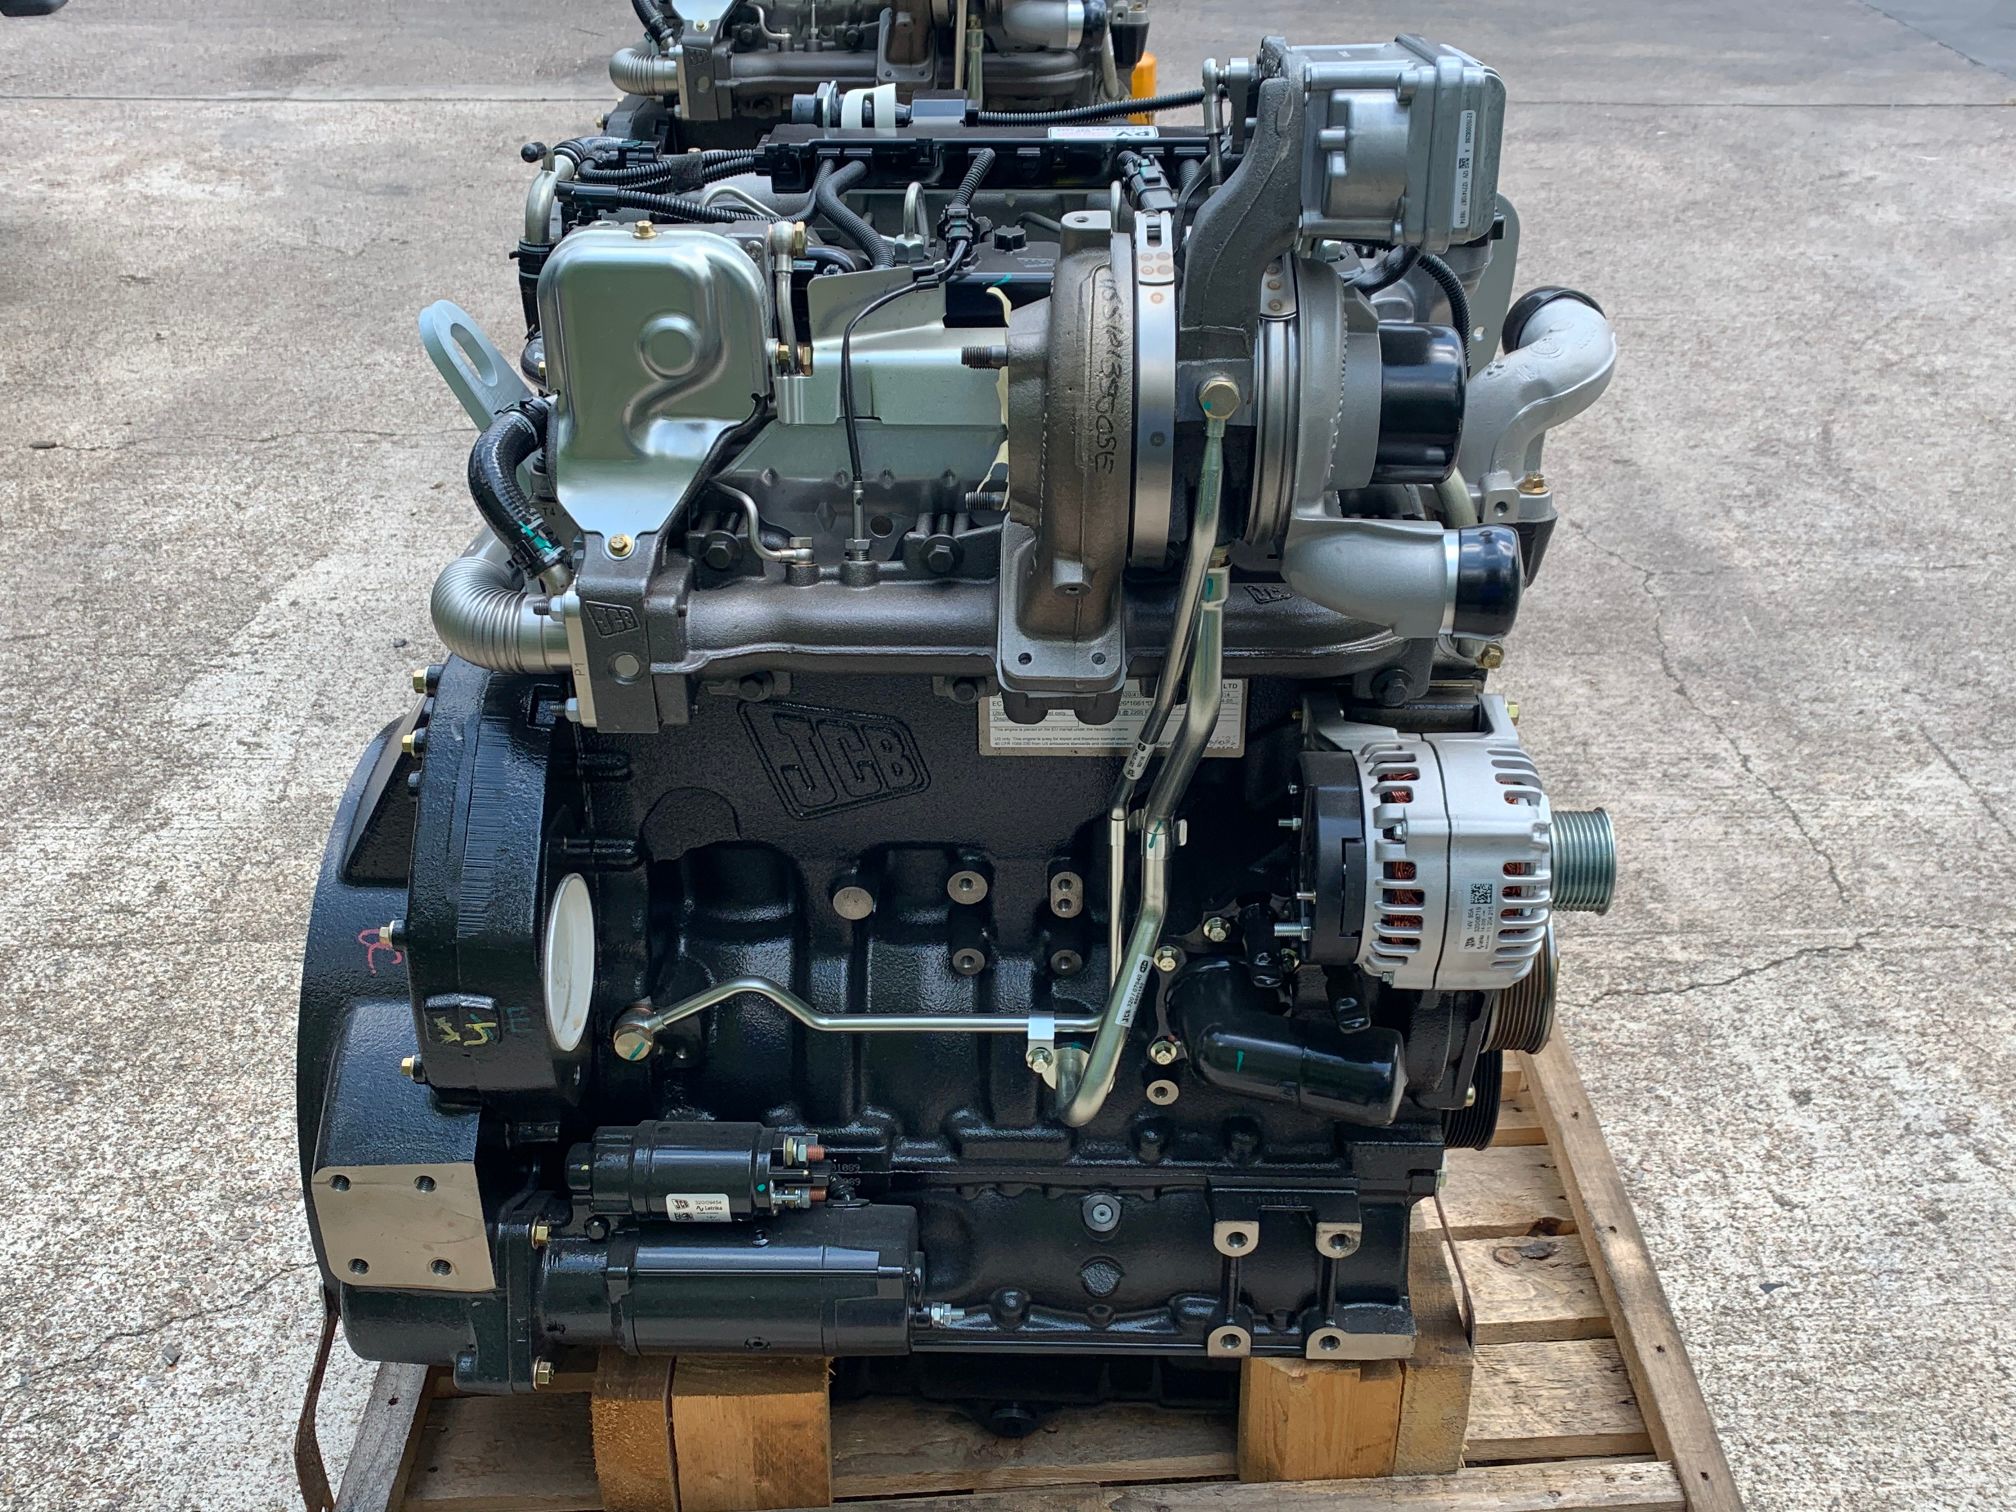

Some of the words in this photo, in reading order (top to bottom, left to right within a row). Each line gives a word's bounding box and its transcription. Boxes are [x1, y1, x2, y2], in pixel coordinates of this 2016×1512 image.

[591, 604, 636, 635] JCB
[574, 662, 585, 676] P1
[765, 707, 922, 813] JCB
